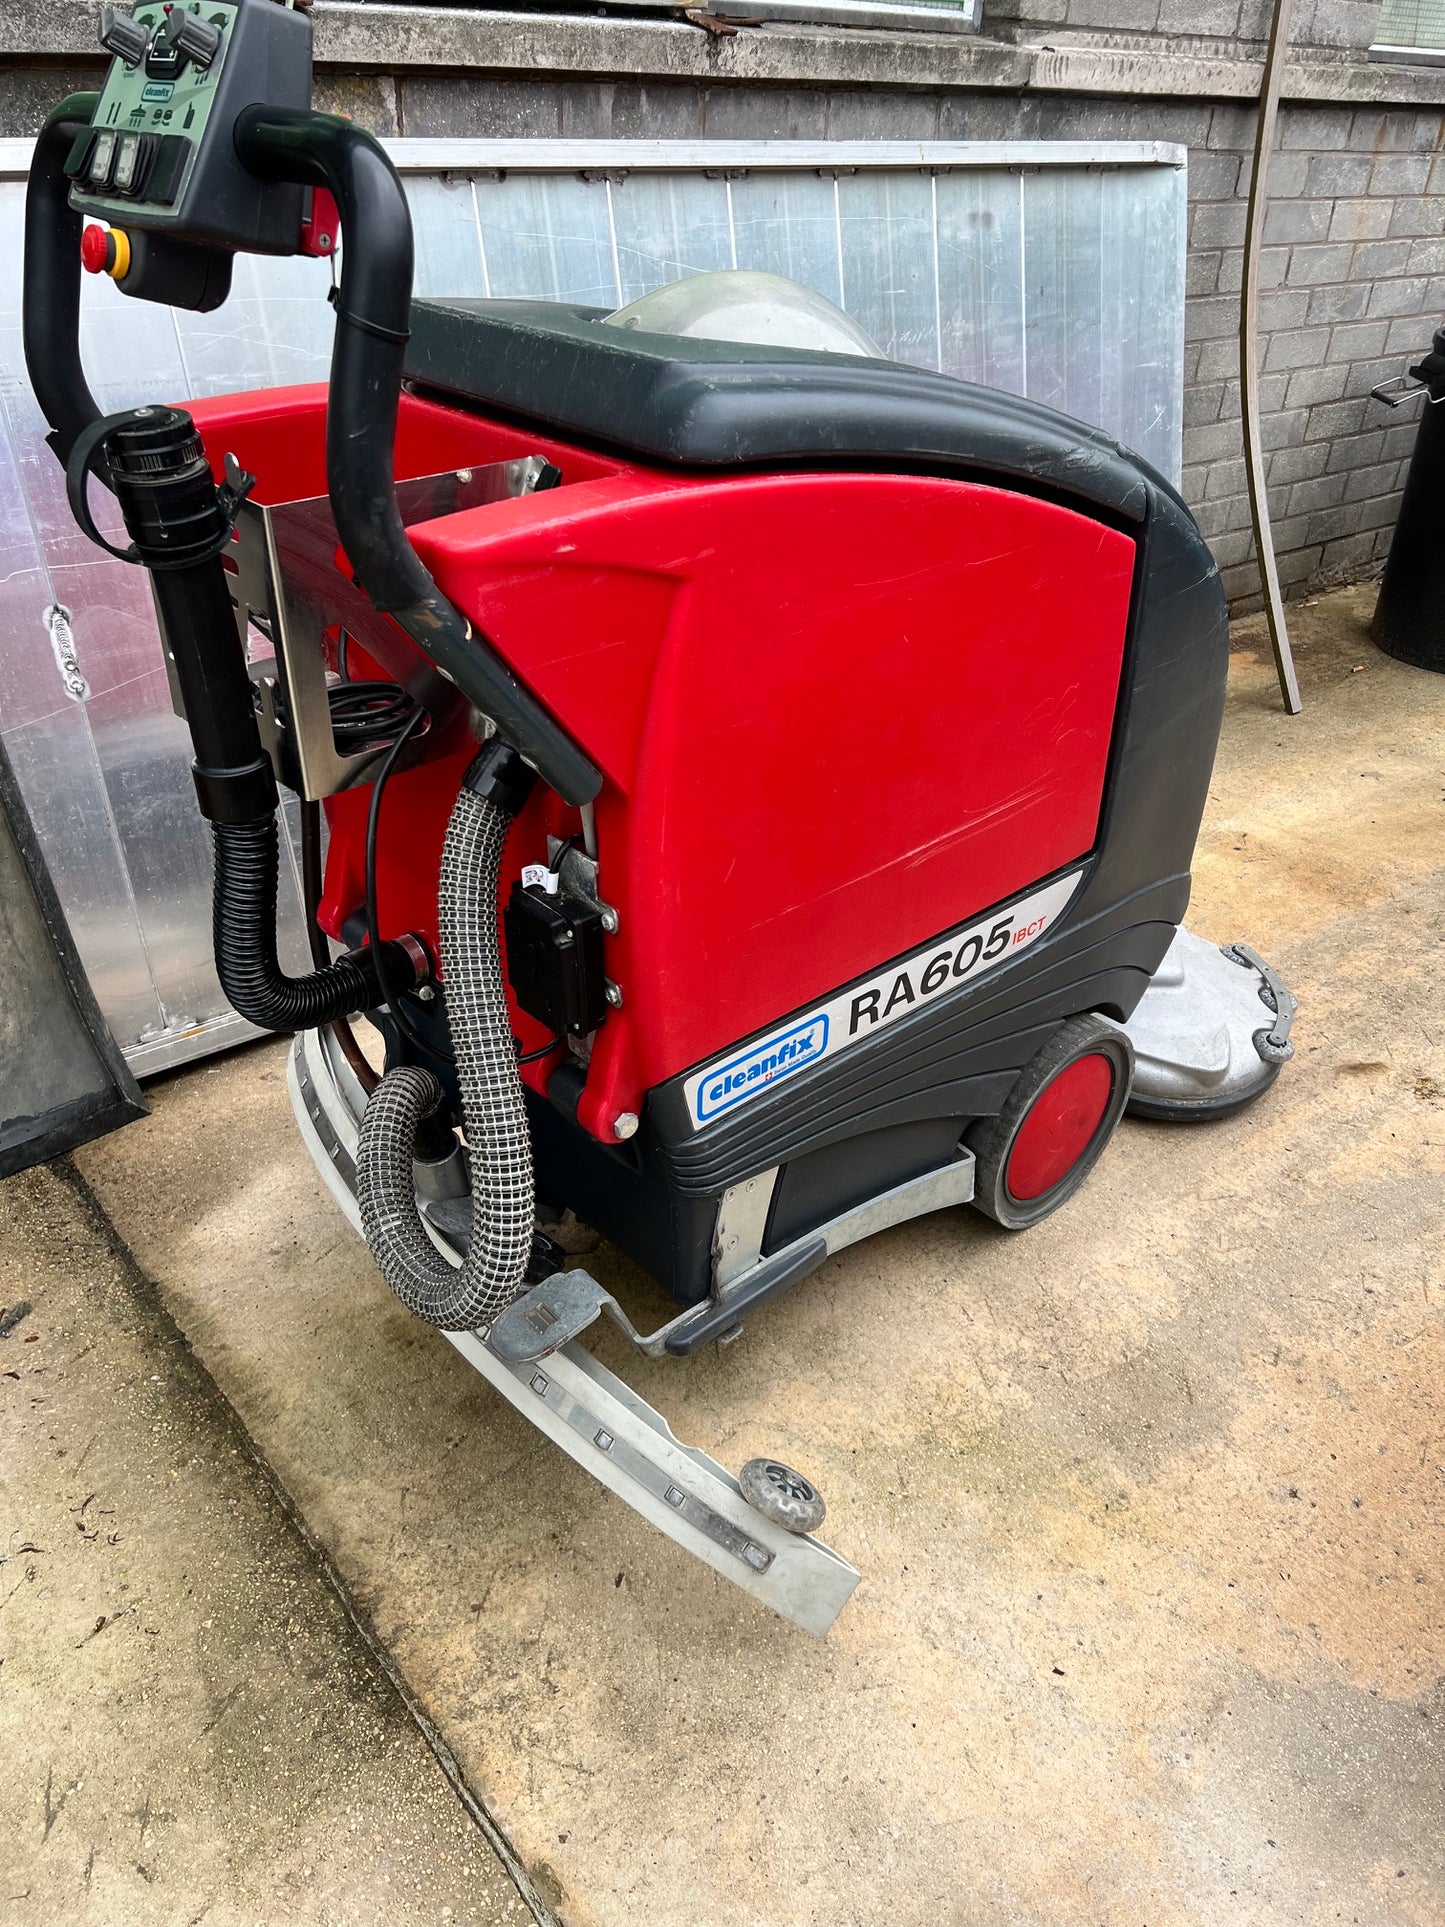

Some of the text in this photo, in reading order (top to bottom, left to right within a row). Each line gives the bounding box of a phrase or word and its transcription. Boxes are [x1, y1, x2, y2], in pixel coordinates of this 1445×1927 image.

[849, 915, 1047, 1036] RA605 IBCT
[709, 1033, 814, 1101] cleanfix
